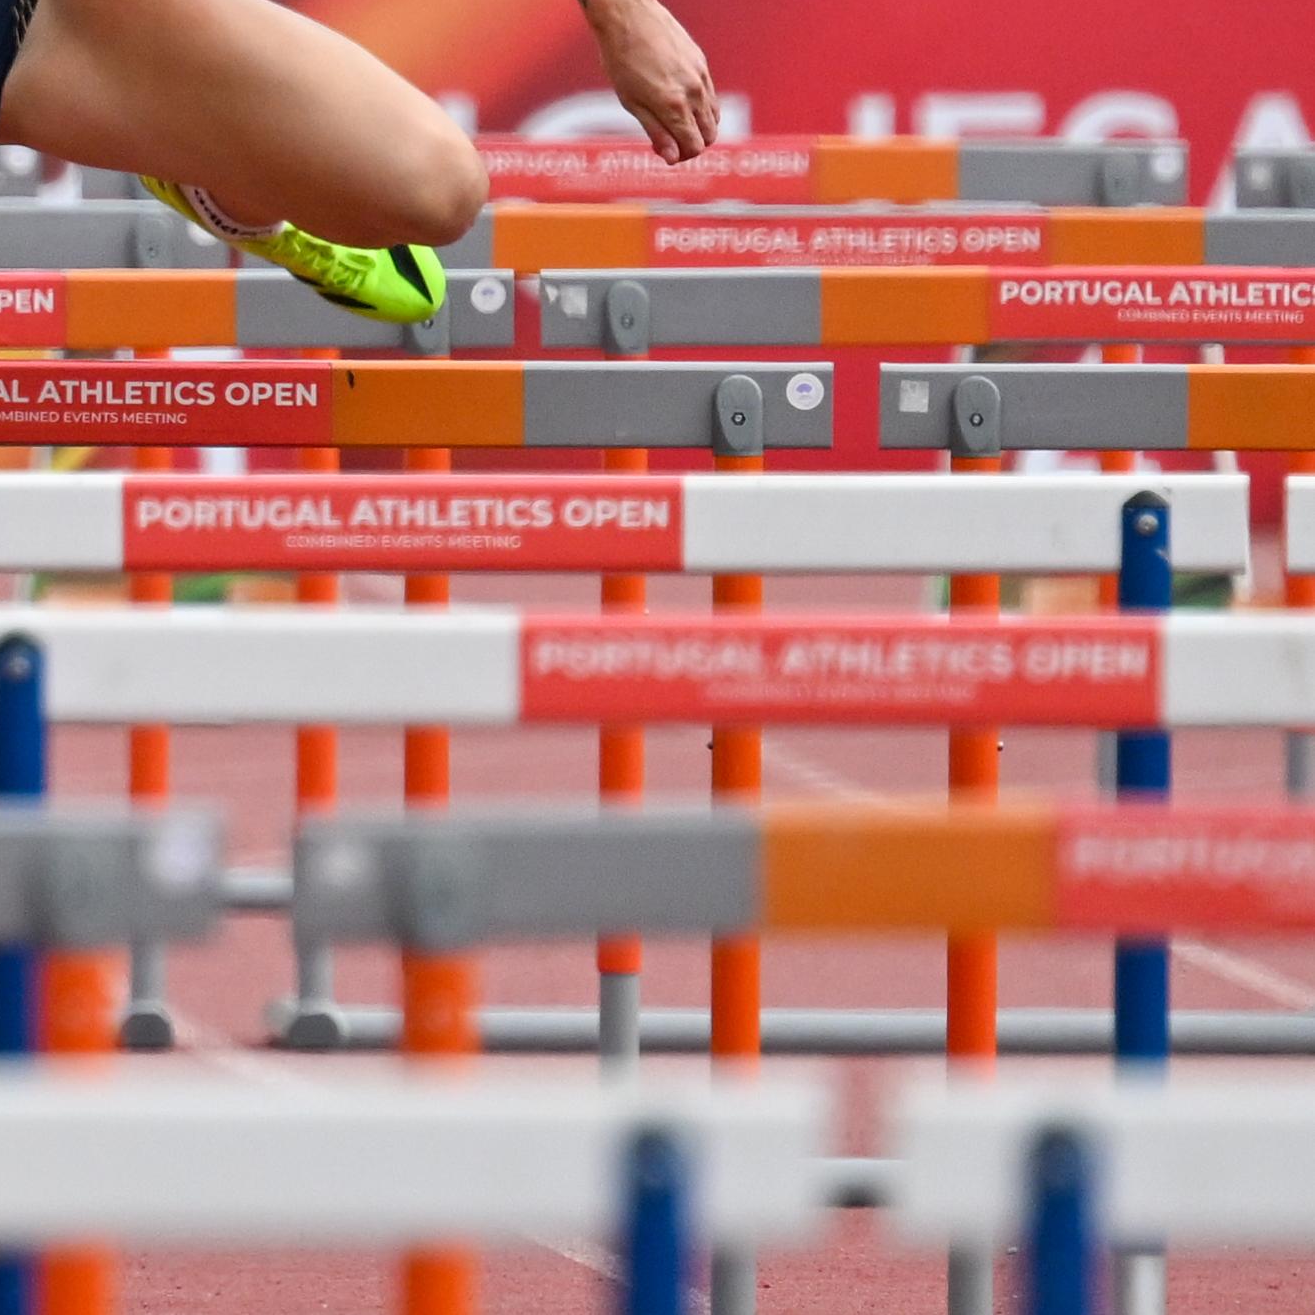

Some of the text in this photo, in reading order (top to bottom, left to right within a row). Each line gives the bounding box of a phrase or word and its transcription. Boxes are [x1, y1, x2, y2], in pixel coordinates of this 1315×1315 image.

[655, 227, 1042, 253] PORTUGAL ATHLETICS OPEN
[1000, 280, 1315, 306] PORTUGAL ATHLETIC
[36, 379, 216, 406] ATHLETICS
[224, 381, 318, 407] OPEN
[63, 410, 119, 424] EVENTS
[122, 411, 188, 425] MEETING
[138, 498, 669, 529] PORTUGAL ATHLETICS OPEN
[285, 534, 522, 549] COMBINED EVENTS MEETING
[534, 640, 1149, 679] PORTUGAL ATHLETICS OPEN
